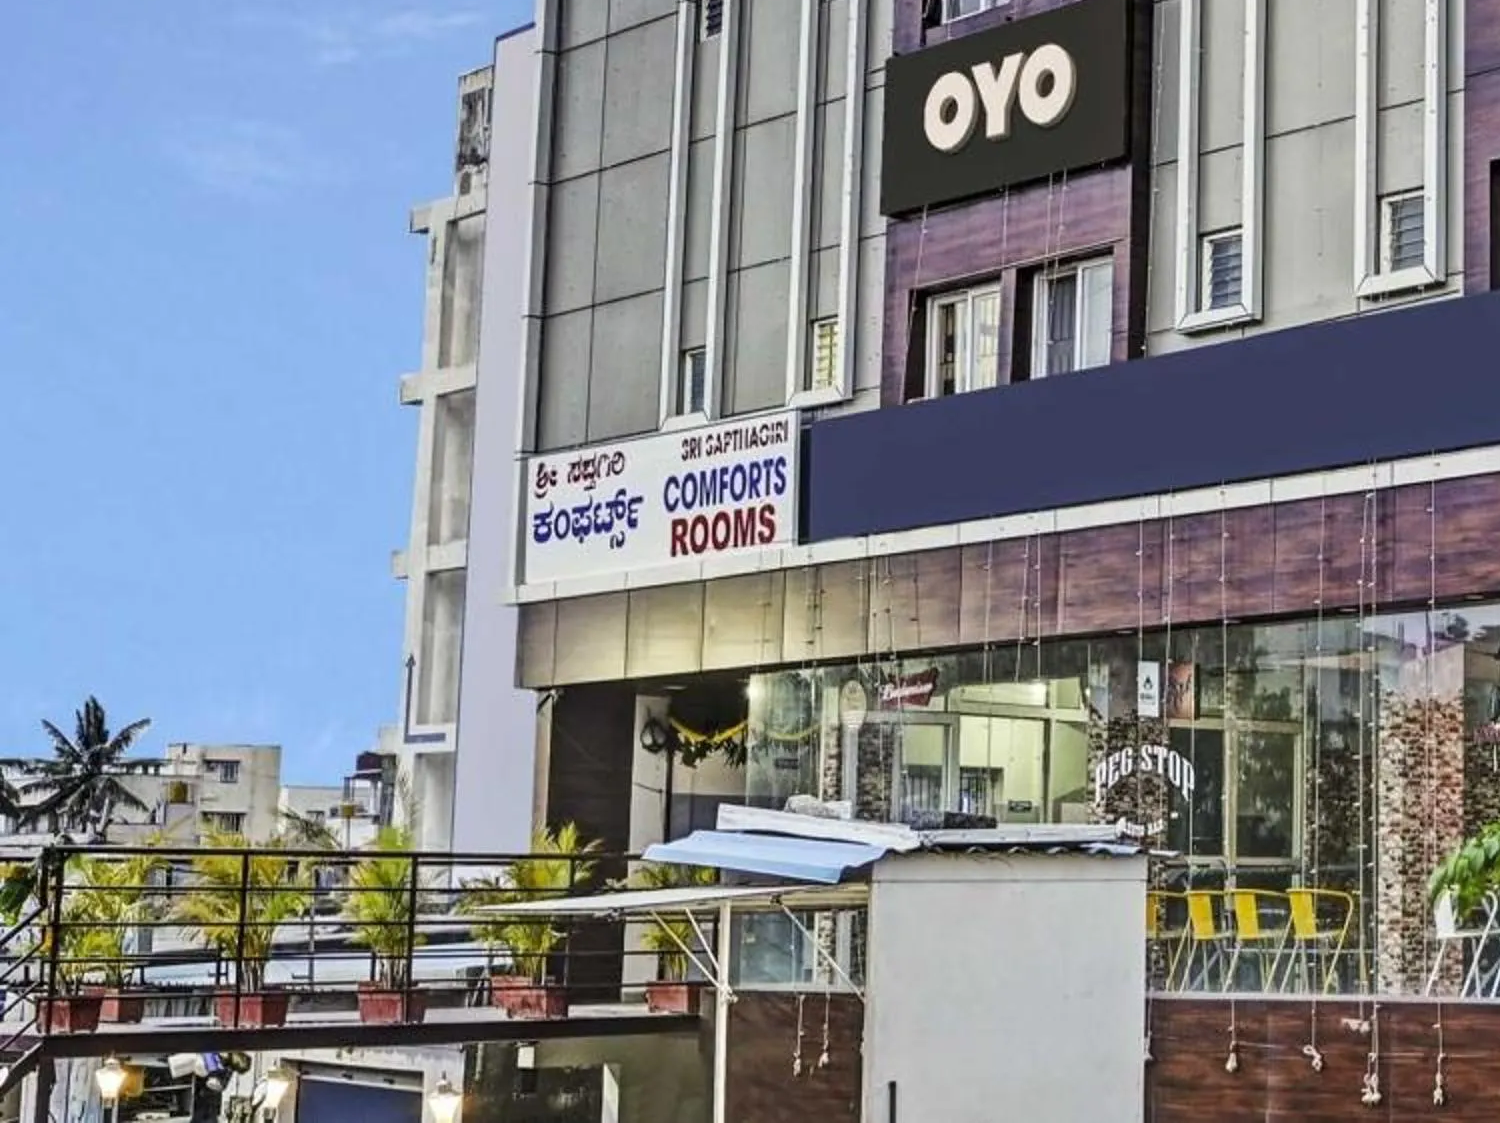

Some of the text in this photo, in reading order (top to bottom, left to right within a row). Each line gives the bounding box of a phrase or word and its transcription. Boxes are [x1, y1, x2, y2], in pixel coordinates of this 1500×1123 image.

[923, 42, 1077, 153] OYO
[681, 435, 702, 462] SRI
[663, 456, 788, 513] COMFORTS
[670, 503, 777, 557] ROOMS
[1140, 744, 1195, 801] STOP
